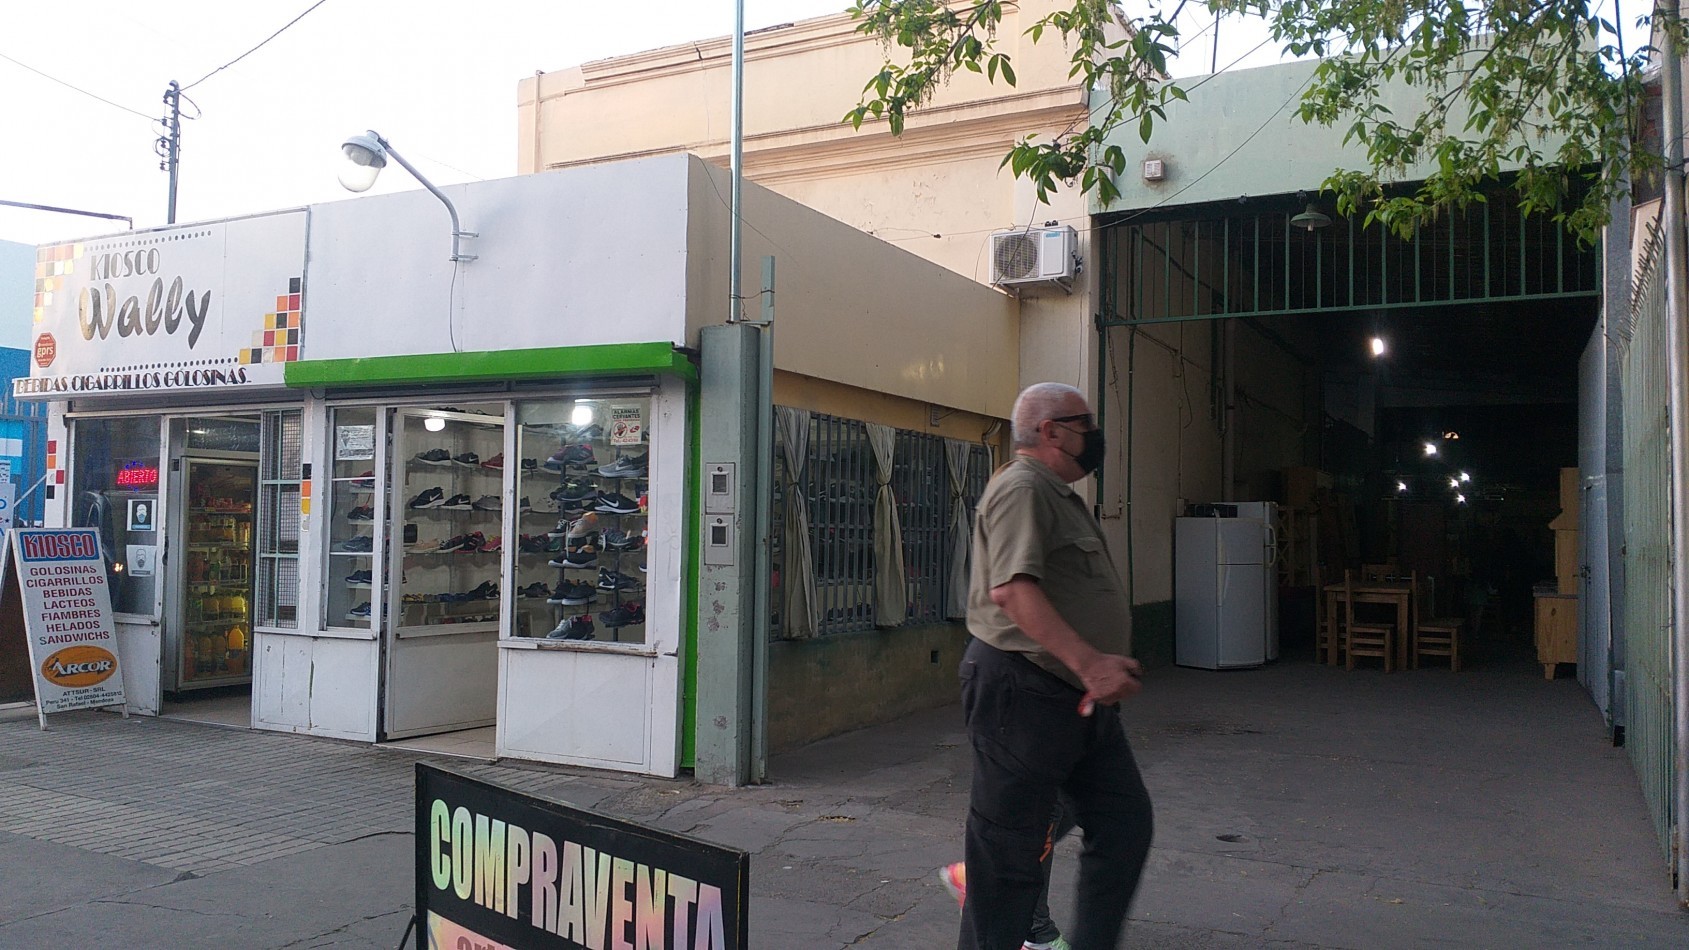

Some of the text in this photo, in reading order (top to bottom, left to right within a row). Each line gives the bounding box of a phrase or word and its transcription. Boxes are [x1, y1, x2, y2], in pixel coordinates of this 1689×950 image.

[90, 248, 160, 280] KIOSCO
[79, 276, 211, 350] Wally
[36, 346, 54, 358] gprs
[117, 469, 157, 484] ABIERTO
[23, 534, 96, 558] KIOSCO
[30, 565, 97, 576] GOLOSINAS
[26, 575, 104, 588] CIGARRILLOS
[43, 587, 92, 598] BEBIDAS
[43, 598, 95, 609] LACTEOS
[41, 609, 101, 621] FIAMBRES
[46, 620, 100, 632] HELADOS
[39, 631, 110, 645] SANDWICHS
[51, 660, 112, 675] ARCOR
[430, 799, 725, 950] COMPRAVENTA
